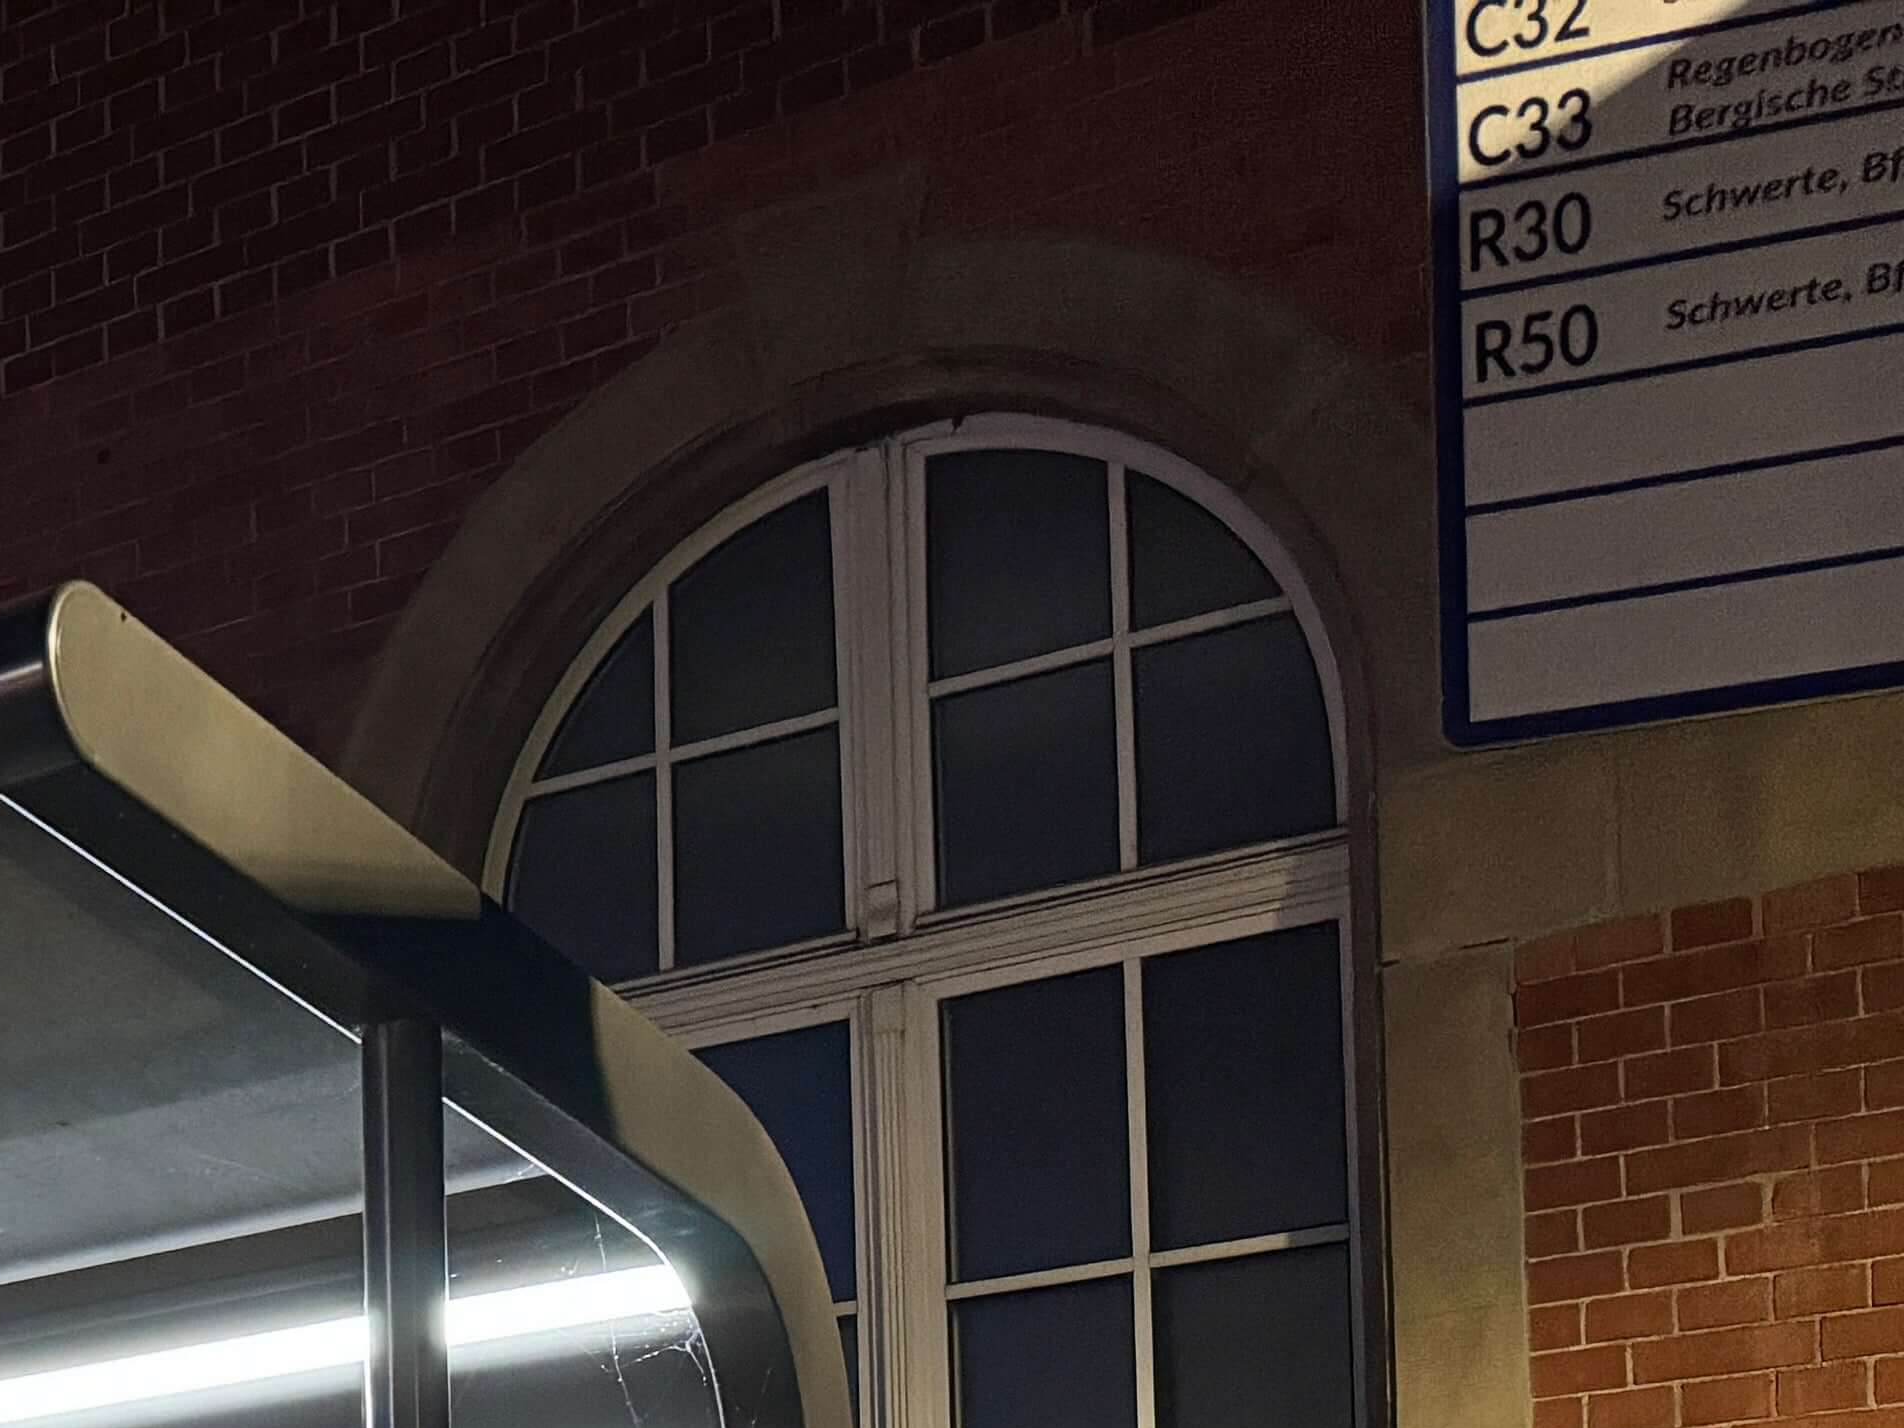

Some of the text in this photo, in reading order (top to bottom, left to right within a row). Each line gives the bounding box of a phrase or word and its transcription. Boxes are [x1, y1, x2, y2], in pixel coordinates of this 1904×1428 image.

[1465, 0, 1591, 58] C32
[1468, 87, 1593, 166] C33
[1668, 75, 1852, 137] Bergische
[1469, 191, 1592, 272] R30
[1663, 165, 1848, 221] Schwerte,
[1475, 303, 1599, 383] R50
[1665, 275, 1852, 331] Schwerte,
